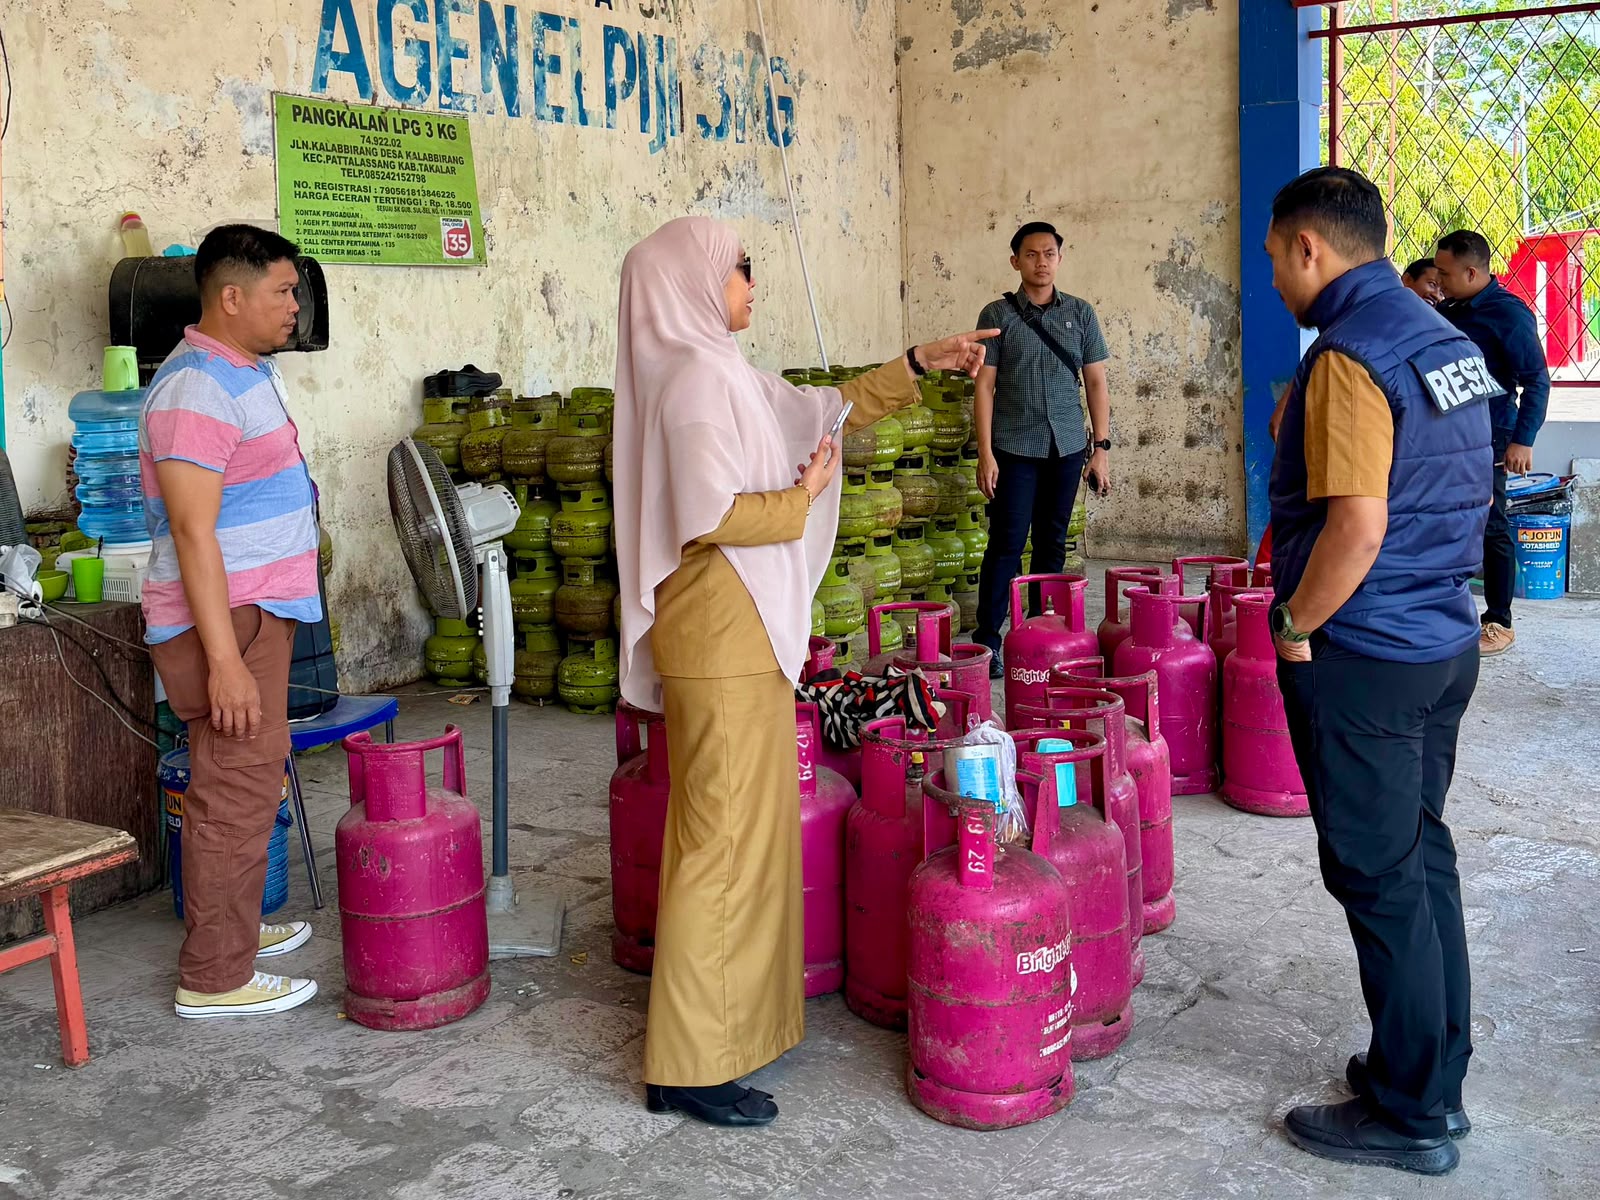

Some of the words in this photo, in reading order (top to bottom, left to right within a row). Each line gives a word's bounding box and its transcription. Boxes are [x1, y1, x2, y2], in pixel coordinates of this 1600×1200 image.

[311, 0, 520, 118] AGEN
[292, 104, 389, 133] PANGKALAN
[392, 117, 421, 136] LPG
[424, 121, 434, 138] 3
[436, 122, 457, 140] KG
[360, 135, 402, 148] 74.922.02
[290, 139, 379, 157] JLN.KALABBIRANG
[380, 148, 404, 160] DESA
[405, 150, 465, 165] KALABBIRANG
[302, 152, 396, 170] KEC.PATTALASSANG
[397, 161, 457, 175] KAB.TAKALAR
[340, 167, 427, 184] TELP.085242152798
[293, 180, 311, 190] NO.
[314, 181, 372, 194] REGISTRASI
[379, 186, 456, 199] 790561813846226
[294, 190, 330, 201] HARGA
[332, 193, 371, 203] ECERAN
[372, 195, 423, 206] TERTINGGI
[445, 200, 472, 209] 18.500
[295, 209, 321, 217] KONTAK
[322, 211, 360, 219] PENGADUAN
[303, 229, 339, 237] PELAYANAN
[362, 231, 392, 239] SETEMPAT
[359, 222, 373, 230] JAYA
[445, 233, 468, 252] 135
[1530, 530, 1561, 540] JOTUN
